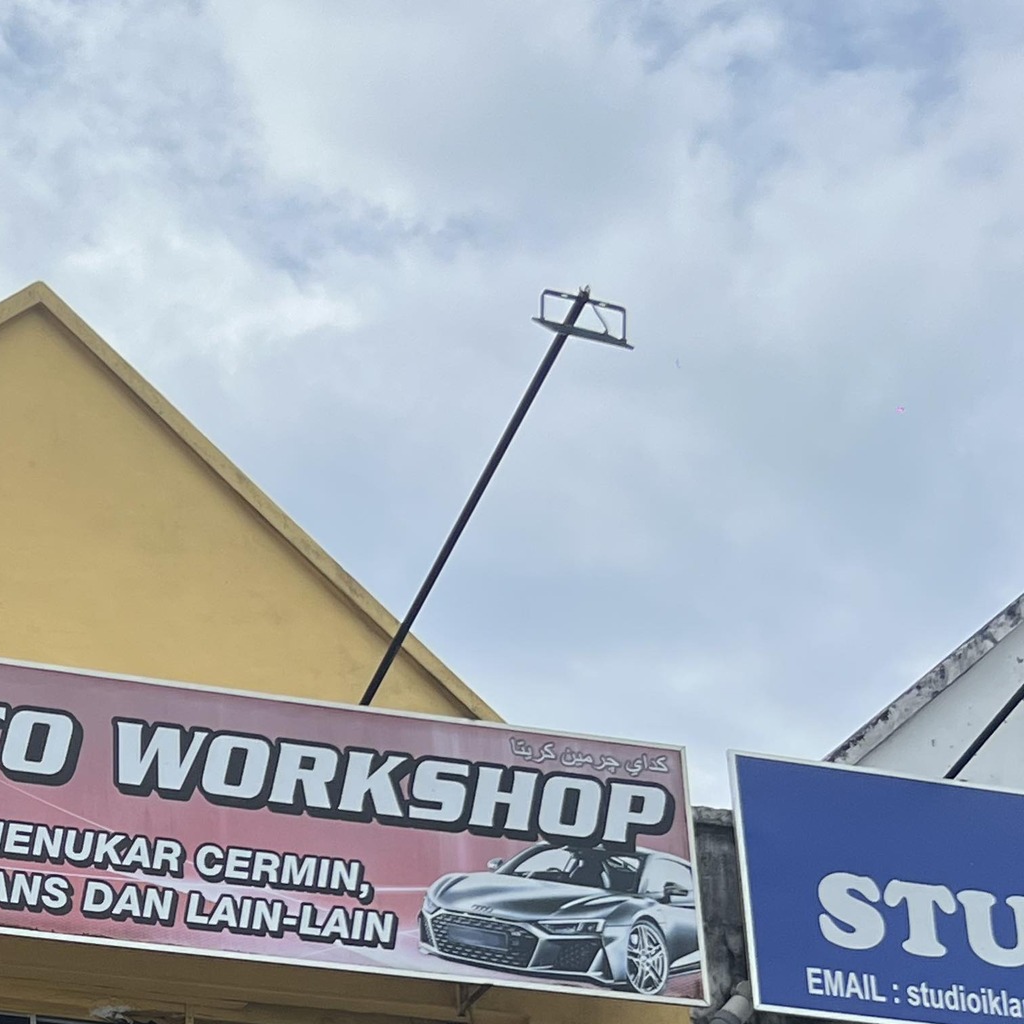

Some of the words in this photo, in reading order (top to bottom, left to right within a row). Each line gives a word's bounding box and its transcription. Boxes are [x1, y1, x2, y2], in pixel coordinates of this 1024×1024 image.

[113, 717, 672, 848] WORKSHOP
[194, 843, 373, 900] CERMIN,
[82, 883, 177, 925] DAN
[184, 894, 399, 948] LAIN-LAIN
[806, 966, 887, 1002] EMAIL
